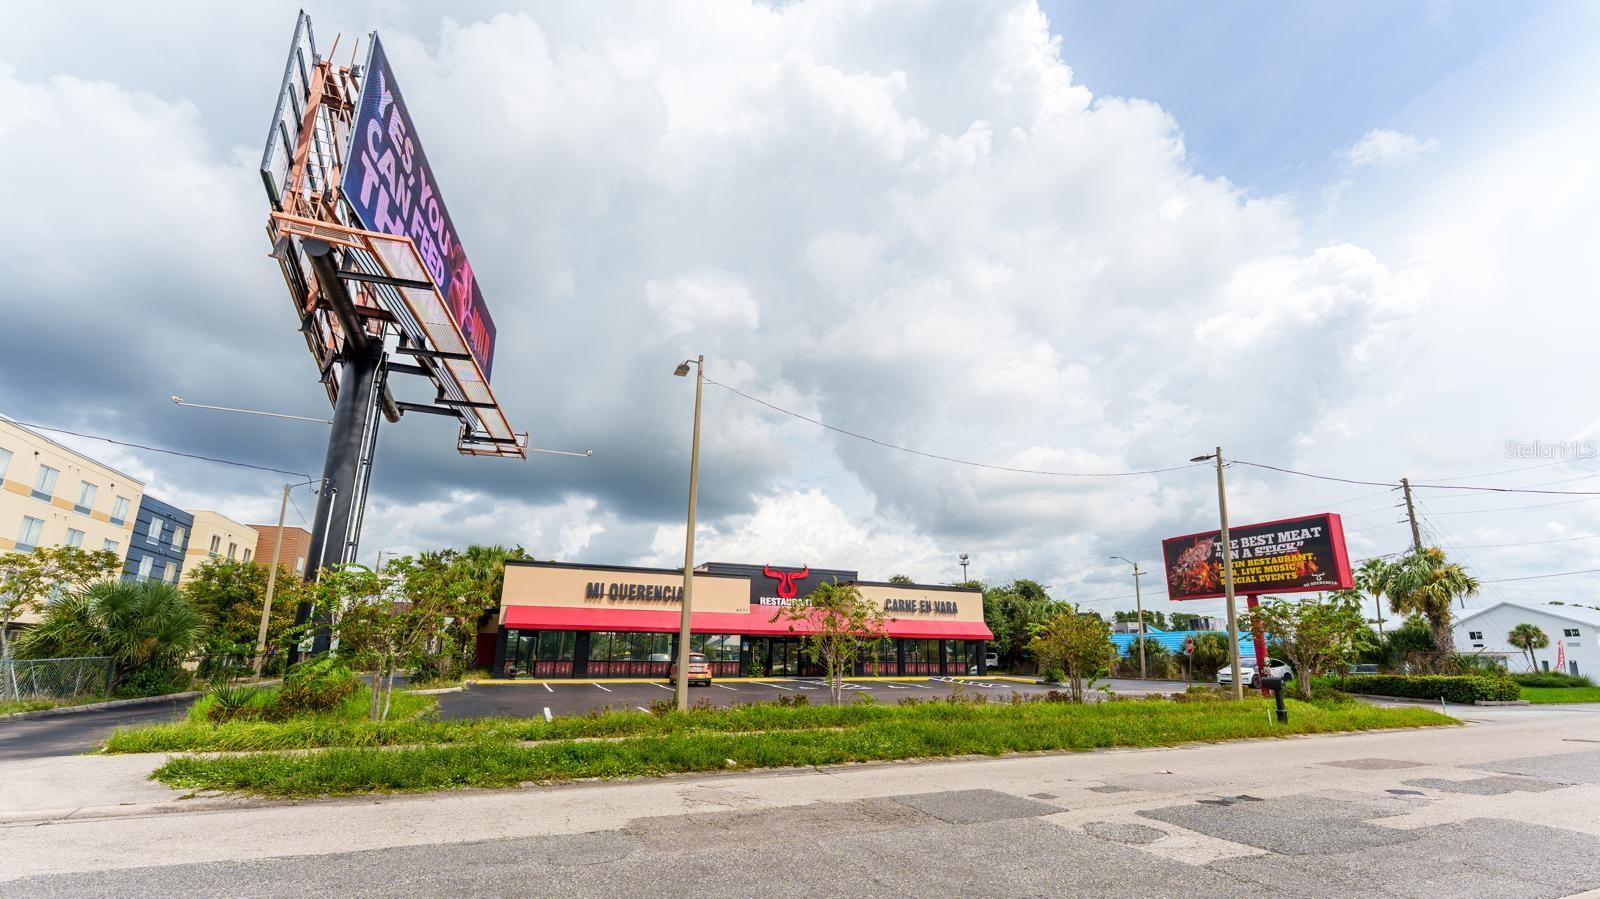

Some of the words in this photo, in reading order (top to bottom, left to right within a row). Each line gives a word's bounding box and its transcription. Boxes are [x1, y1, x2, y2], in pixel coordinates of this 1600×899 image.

[379, 70, 416, 187] YES,
[420, 167, 450, 257] YOU
[367, 118, 411, 221] CAN
[411, 206, 444, 287] FEED
[1214, 539, 1239, 551] TE
[1241, 534, 1275, 548] BEST
[1278, 527, 1322, 543] MEAT
[1219, 560, 1246, 570] LTIN
[1247, 552, 1317, 567] RESTAURANT,
[1242, 548, 1252, 558] A
[1220, 569, 1240, 577] BR,
[1241, 566, 1262, 576] LIVE
[1221, 576, 1257, 586] SECIAL
[1260, 572, 1298, 582] EVENTS
[586, 582, 604, 599] MI
[608, 582, 684, 603] QUERENCIA
[884, 598, 917, 612] CARNE
[920, 600, 932, 614] EN
[933, 600, 958, 614] VARA
